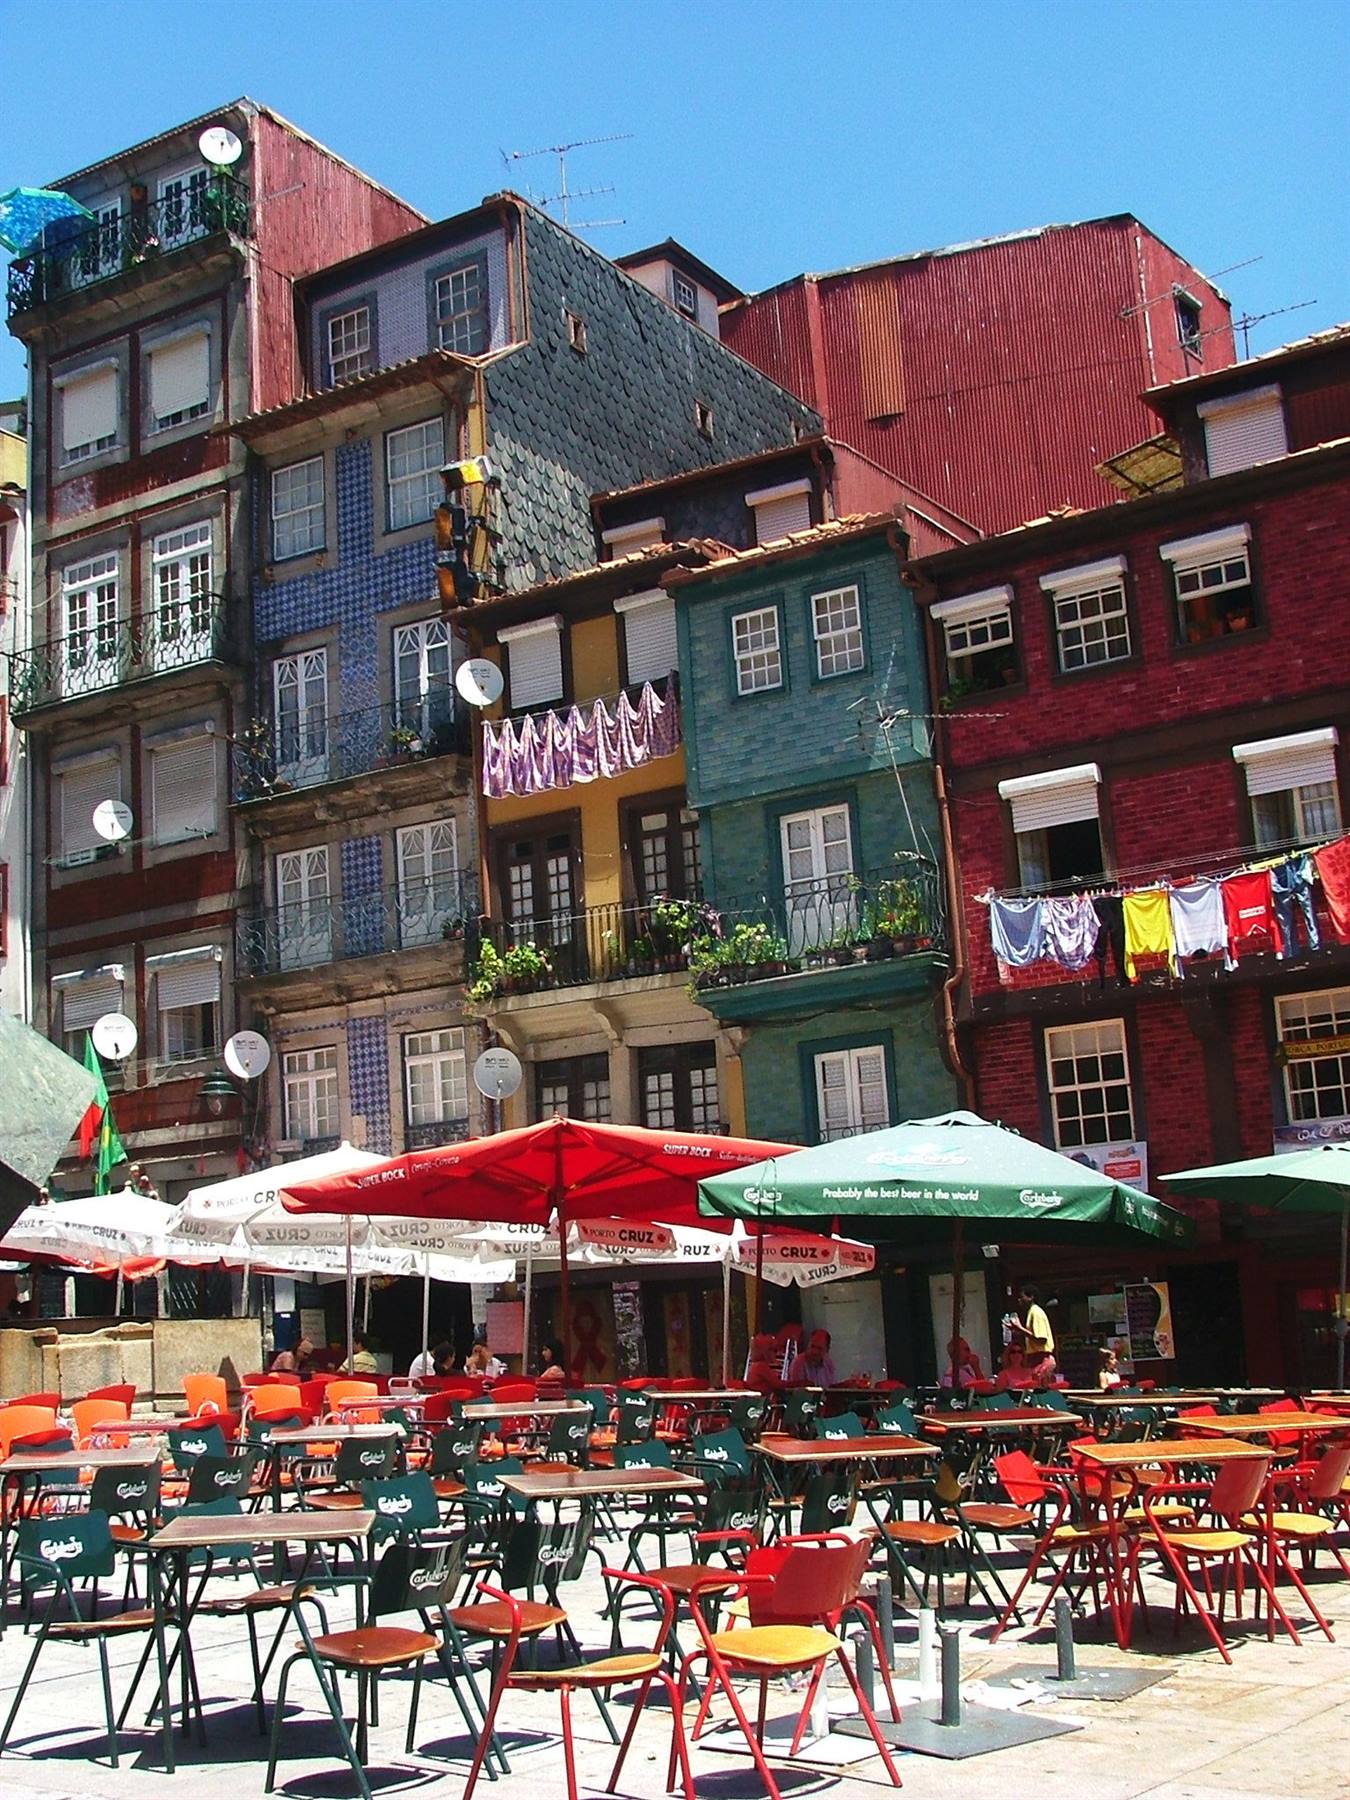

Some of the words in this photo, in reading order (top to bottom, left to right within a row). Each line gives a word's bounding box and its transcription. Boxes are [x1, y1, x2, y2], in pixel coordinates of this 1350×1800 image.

[662, 1143, 689, 1155] SUPER
[689, 1146, 712, 1158] BOCK
[358, 1173, 381, 1189] SUPER
[382, 1168, 405, 1182] BOCK
[823, 1187, 862, 1200] Probably
[864, 1187, 878, 1198] the
[880, 1187, 899, 1198] best
[901, 1188, 921, 1199] beer
[924, 1189, 932, 1199] in
[935, 1189, 949, 1200] the
[952, 1189, 979, 1201] world
[1019, 1190, 1063, 1208] Carlsberg
[93, 1226, 118, 1240] CRUZ
[590, 1228, 615, 1238] PORTO
[618, 1229, 655, 1244] CRUZ
[682, 1245, 711, 1256] RUZ
[780, 1246, 818, 1259] CRUZ
[359, 1449, 386, 1466] Carlsberg
[214, 1469, 242, 1486] Carlsberg
[117, 1480, 147, 1499] Carlsberg
[730, 1508, 758, 1531] Carlsberg
[537, 1542, 575, 1566] Carlsberg
[409, 1564, 450, 1591] Carlsberg
